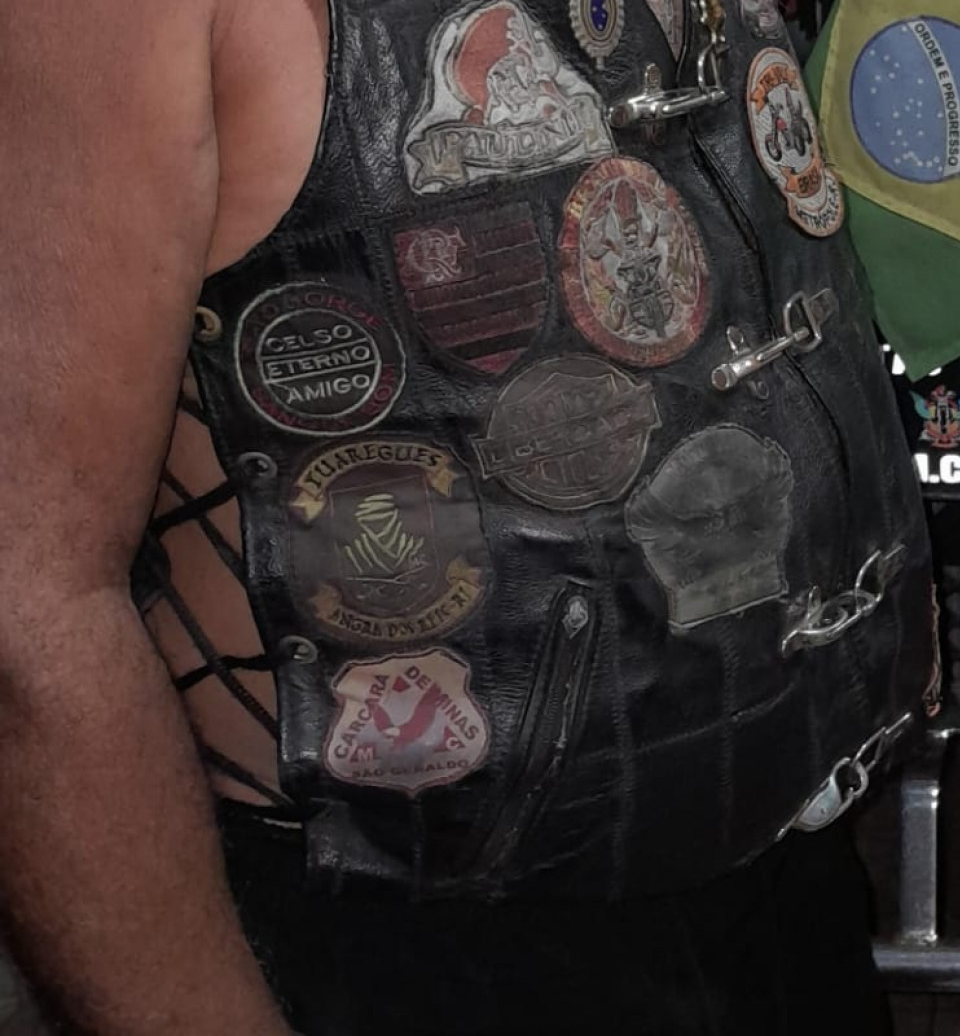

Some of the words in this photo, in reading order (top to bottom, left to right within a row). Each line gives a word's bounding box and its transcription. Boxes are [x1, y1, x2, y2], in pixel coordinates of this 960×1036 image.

[914, 22, 945, 67] ORDEM
[937, 69, 949, 80] E
[942, 82, 960, 167] PROGRESSO
[265, 323, 353, 352] CELSO
[266, 345, 370, 377] ETERNO
[286, 373, 371, 404] AMIGO
[404, 664, 432, 691] DE
